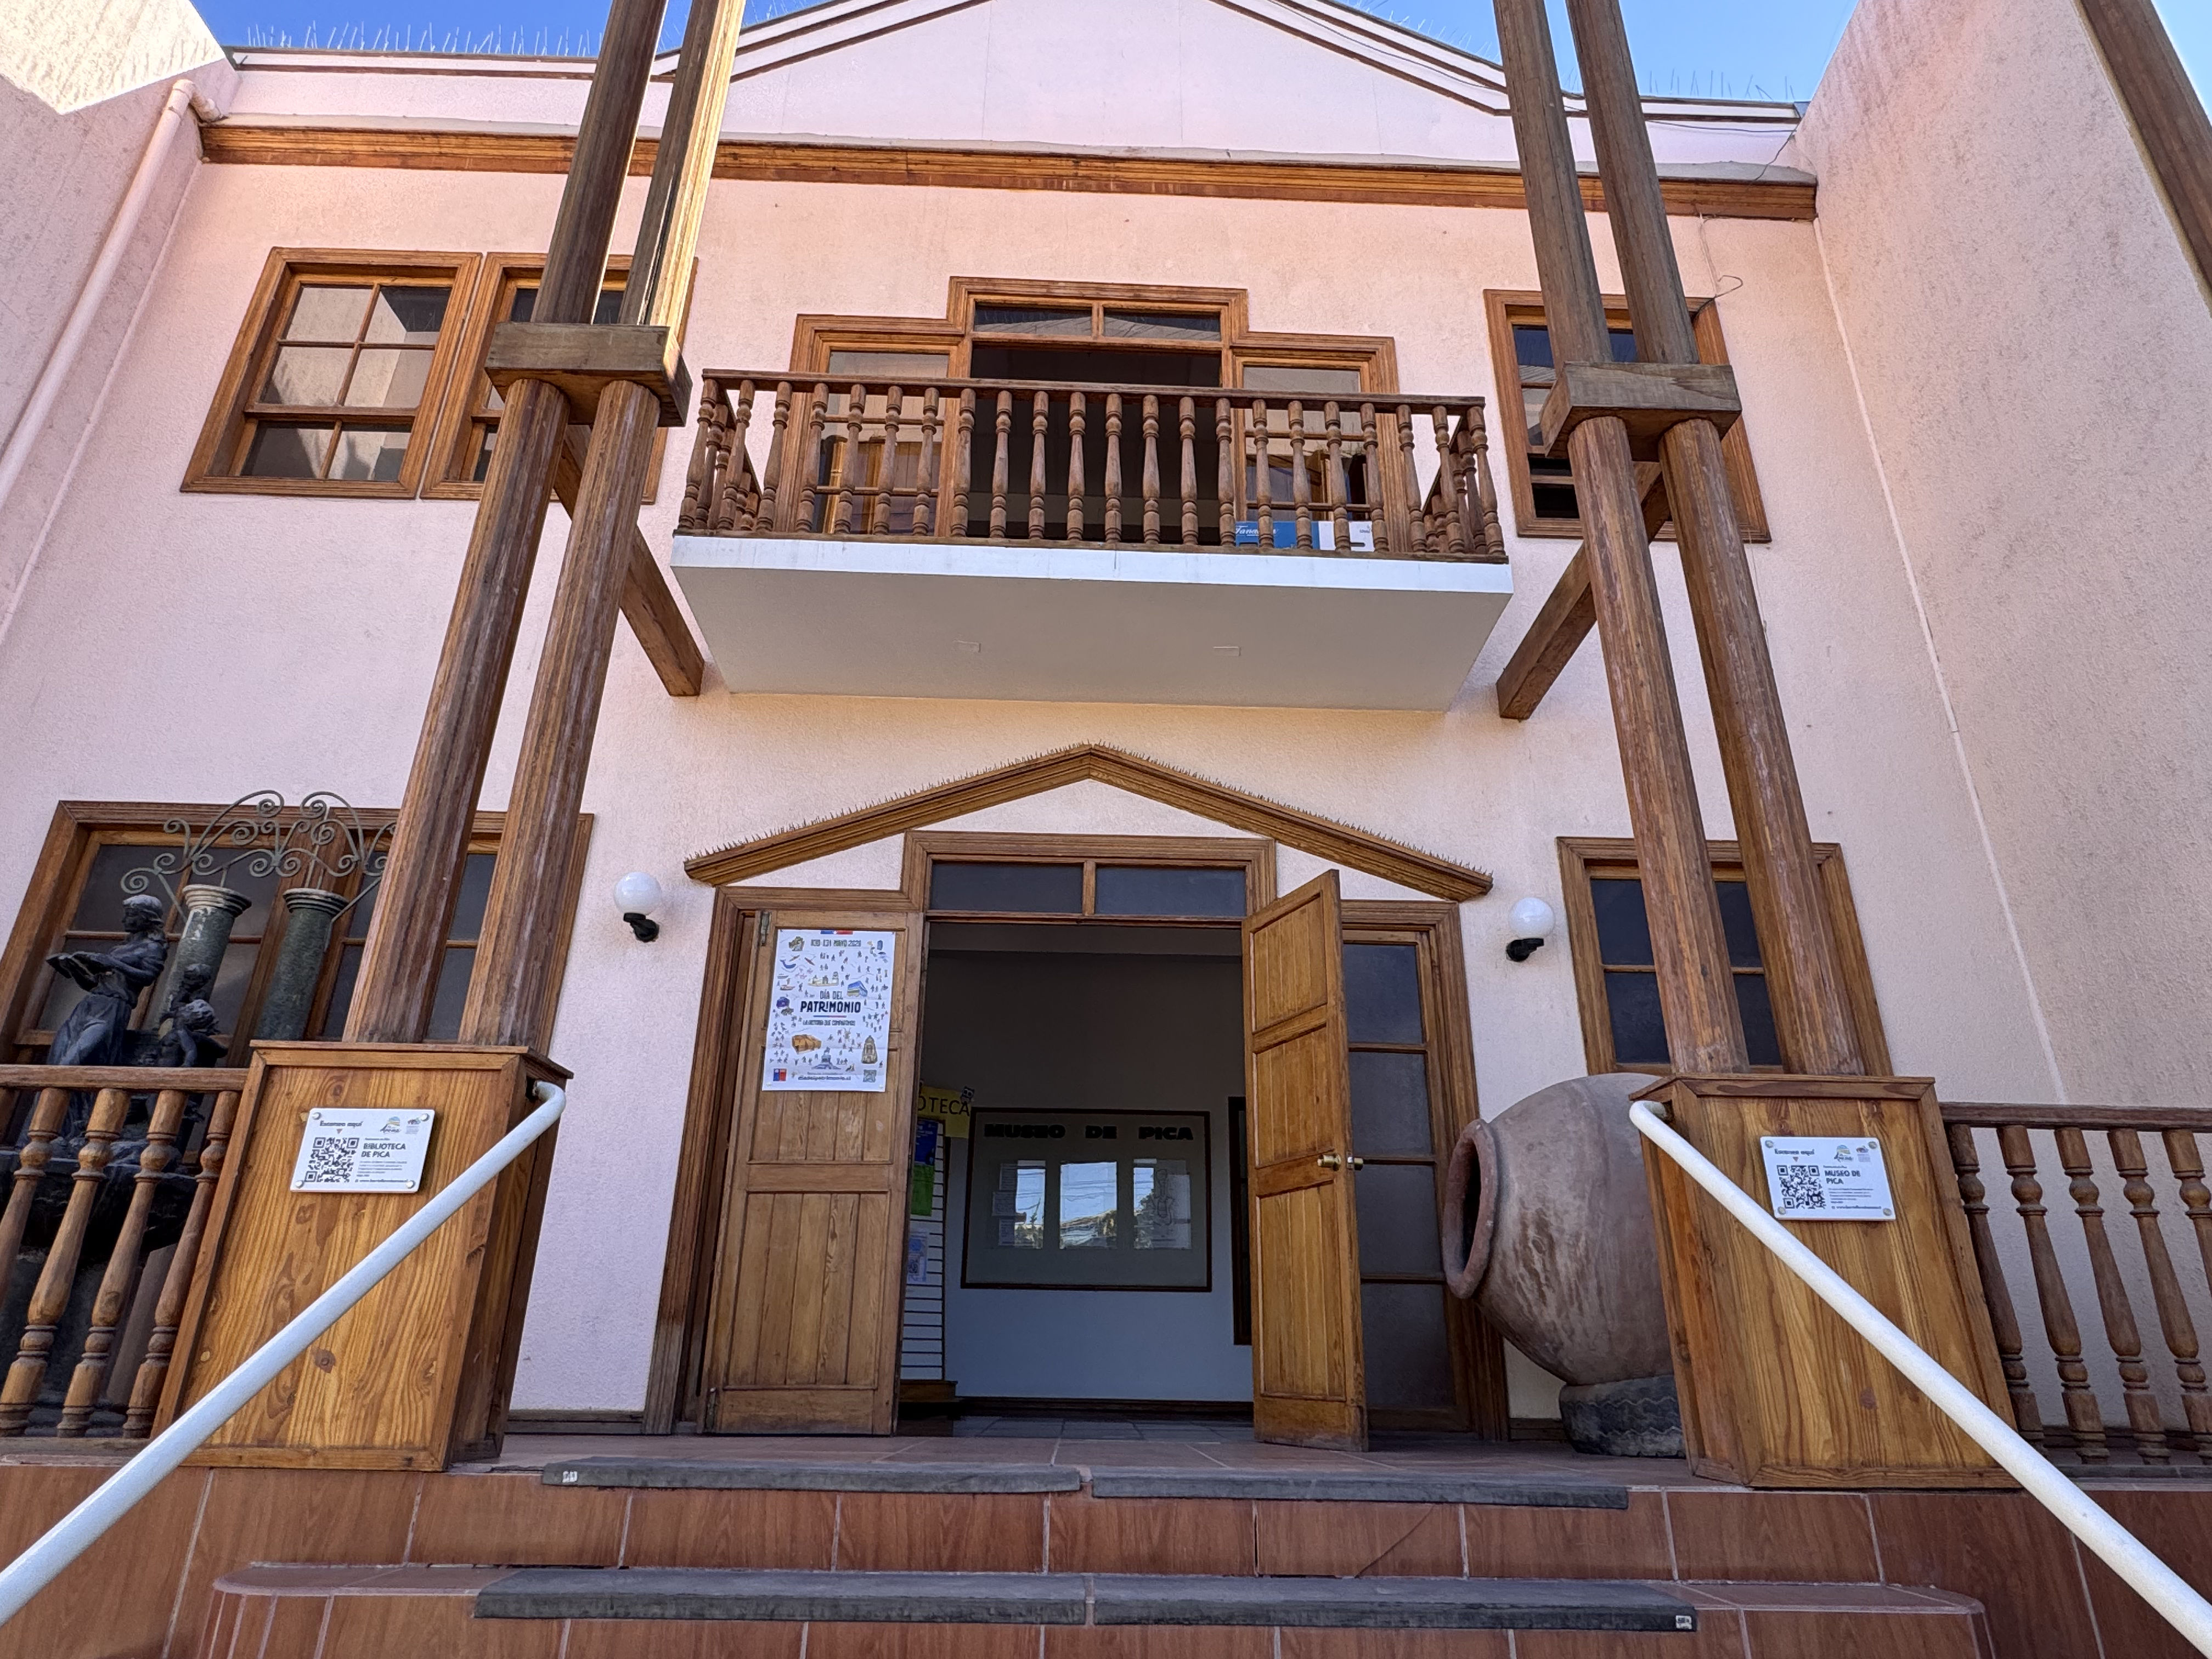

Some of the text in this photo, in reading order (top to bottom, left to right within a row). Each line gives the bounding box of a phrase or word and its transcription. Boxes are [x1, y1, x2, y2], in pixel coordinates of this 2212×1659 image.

[820, 989, 843, 1000] DÍA DEL
[800, 1001, 861, 1013] PATRIMONIO
[984, 1123, 1194, 1140] MUSEO DE PICA
